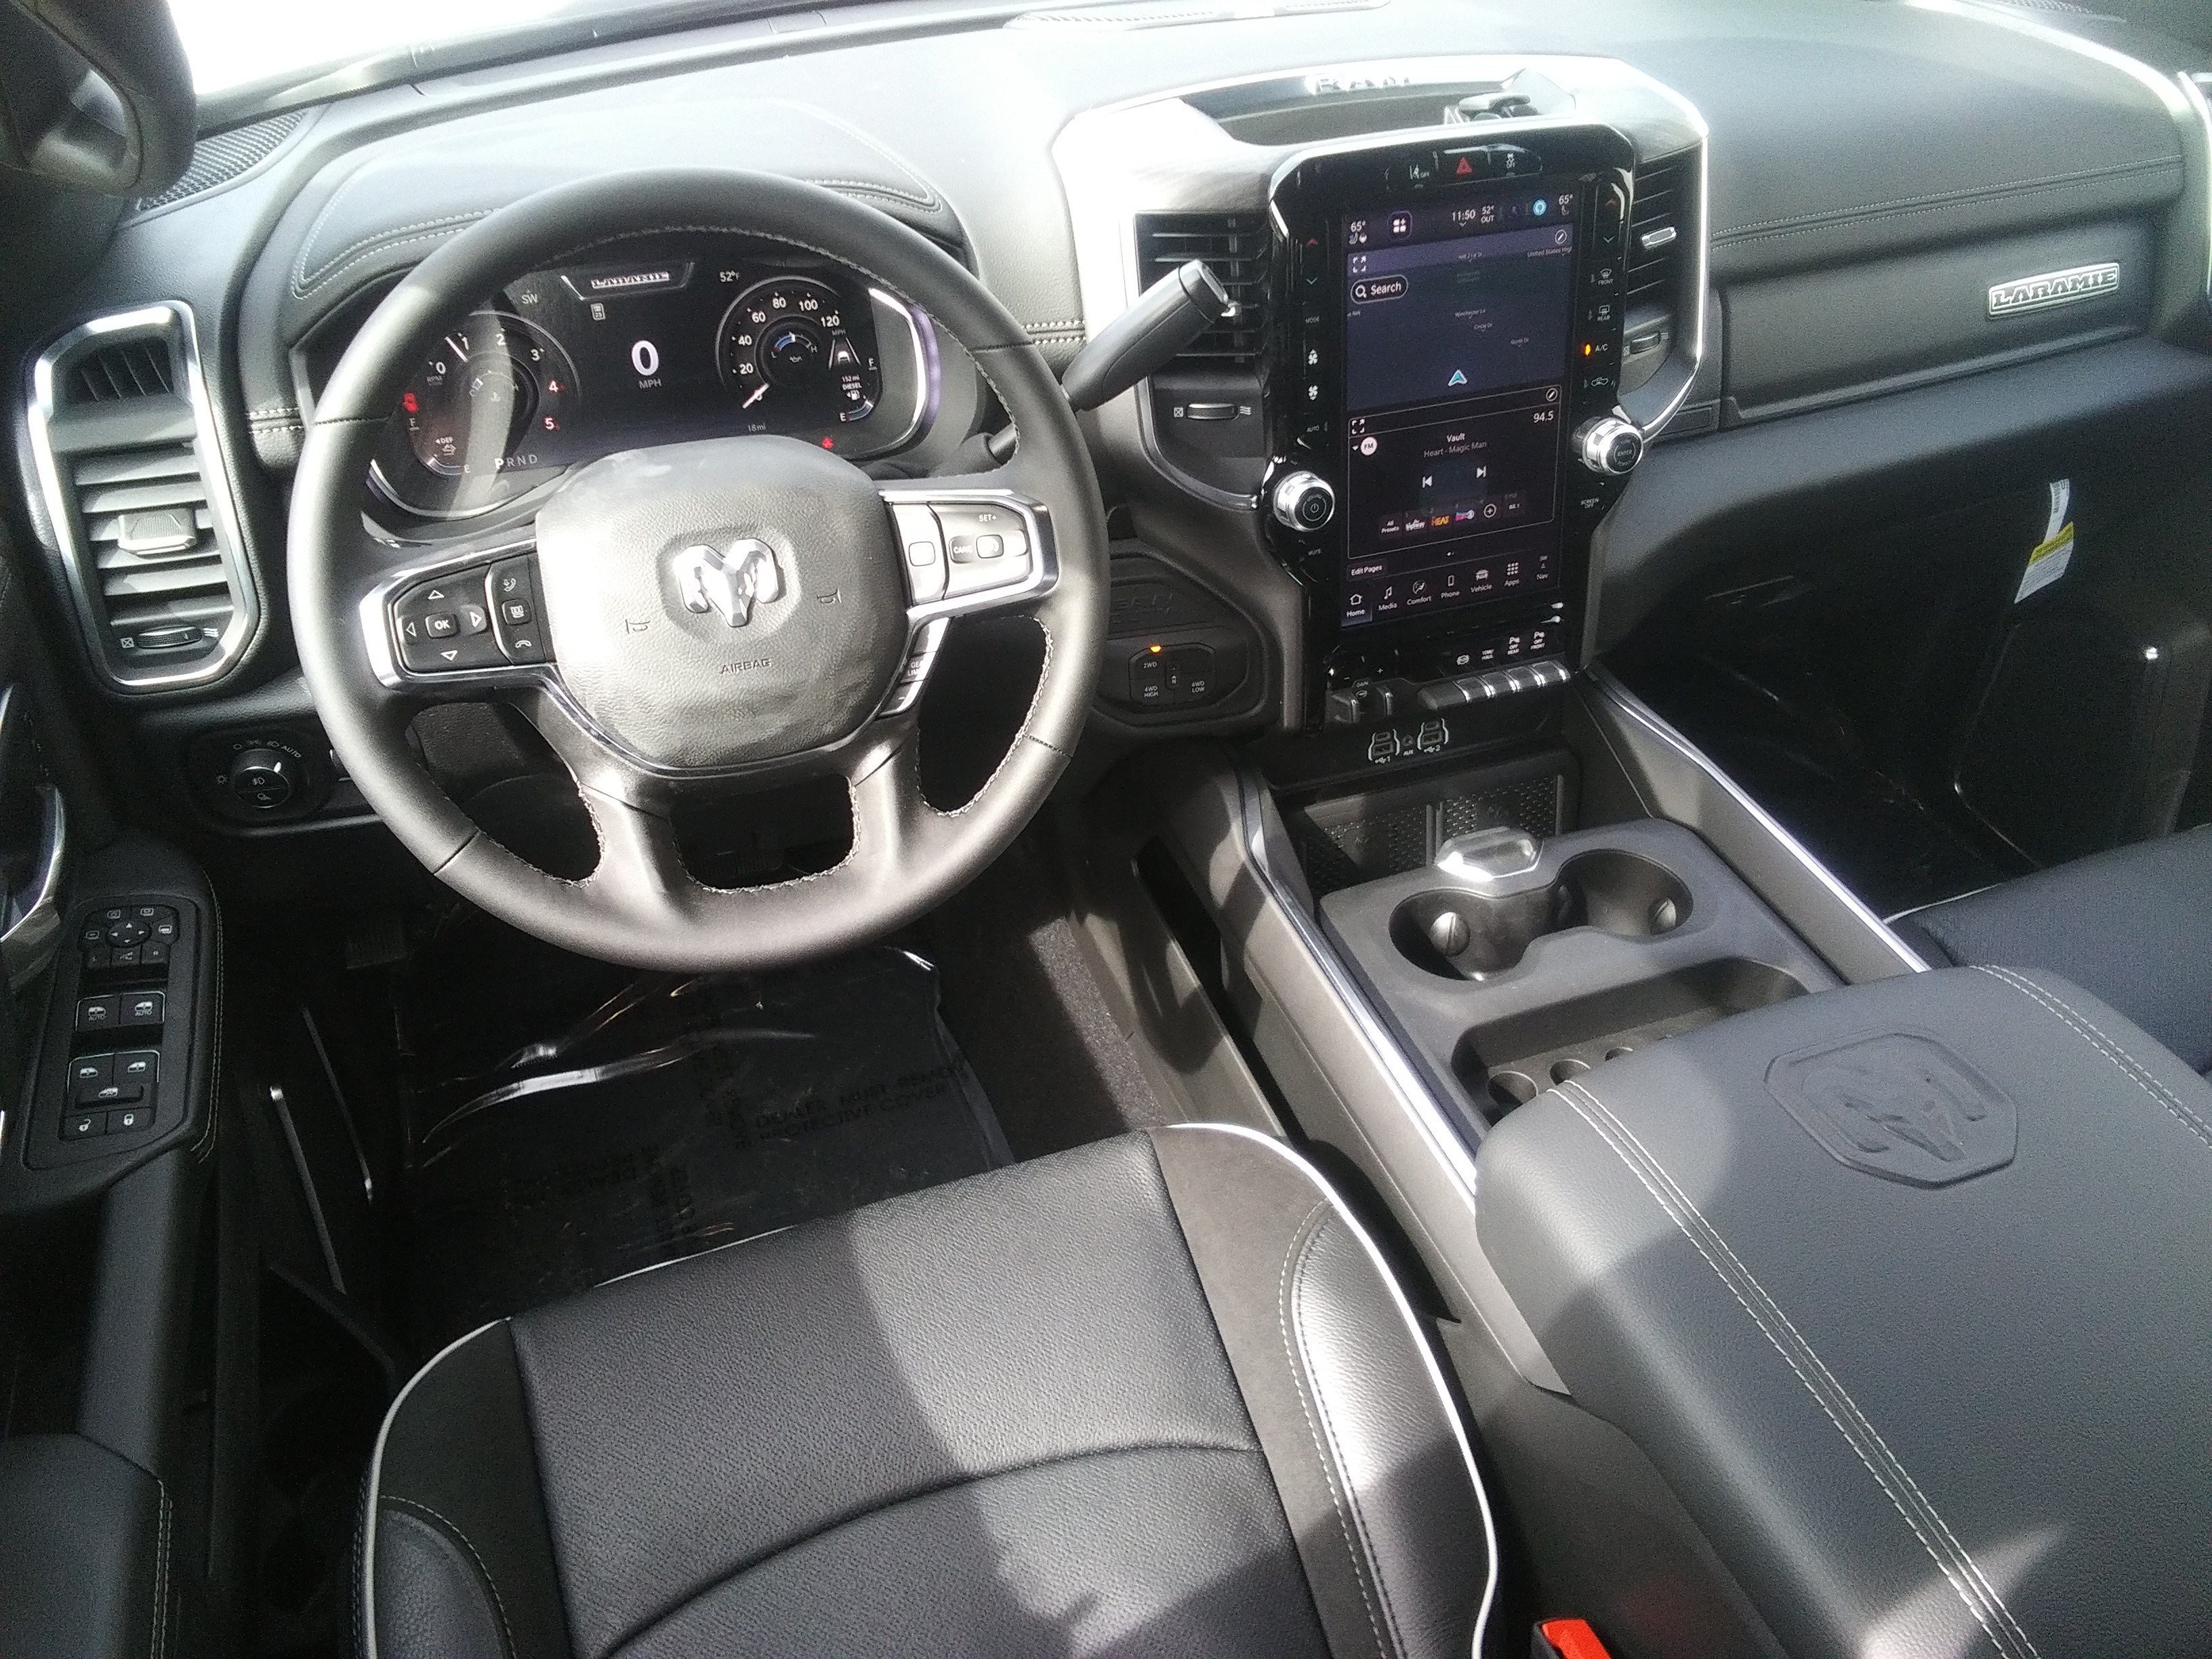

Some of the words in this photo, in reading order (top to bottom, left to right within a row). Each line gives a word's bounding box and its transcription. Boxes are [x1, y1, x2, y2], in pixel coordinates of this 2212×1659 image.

[1452, 208, 1476, 221] 11:50
[1481, 215, 1495, 224] OUT
[1370, 281, 1402, 295] Search
[1598, 278, 1614, 286] FRONT
[1992, 267, 2117, 309] LARAMIE
[522, 293, 538, 304] SW
[773, 297, 787, 308] 80
[799, 299, 818, 311] 100
[752, 311, 766, 323] 60
[821, 315, 840, 327] 120
[462, 337, 469, 350] 1
[496, 333, 506, 346] 2
[738, 335, 752, 346] 40
[1595, 343, 1609, 352] A/C
[531, 348, 540, 361] 3
[631, 340, 659, 376] 0
[435, 362, 447, 374] 0
[739, 363, 754, 375] 20
[548, 380, 558, 393] 4
[638, 379, 661, 389] MPH
[842, 382, 862, 390] DIESEL
[840, 413, 846, 422] E
[1533, 411, 1554, 424] 94.5
[544, 418, 554, 430] 5
[1446, 432, 1465, 443] Vault
[1424, 447, 1444, 458] Heart
[1449, 443, 1469, 455] Magic
[1471, 441, 1488, 451] Man
[464, 464, 471, 474] E
[1381, 526, 1400, 534] Presets
[1351, 565, 1364, 576] Edit
[1364, 563, 1382, 576] Pages
[1471, 582, 1492, 594] Vehicle
[1504, 578, 1520, 588] Apps
[1407, 594, 1432, 605] Comfort
[1441, 589, 1460, 599] Phone
[1347, 607, 1366, 618] Home
[1378, 602, 1397, 611] Media
[434, 619, 451, 630] OK
[719, 658, 771, 675] AIRBAG
[1144, 690, 1159, 698] HIGH
[281, 745, 302, 759] AUTO
